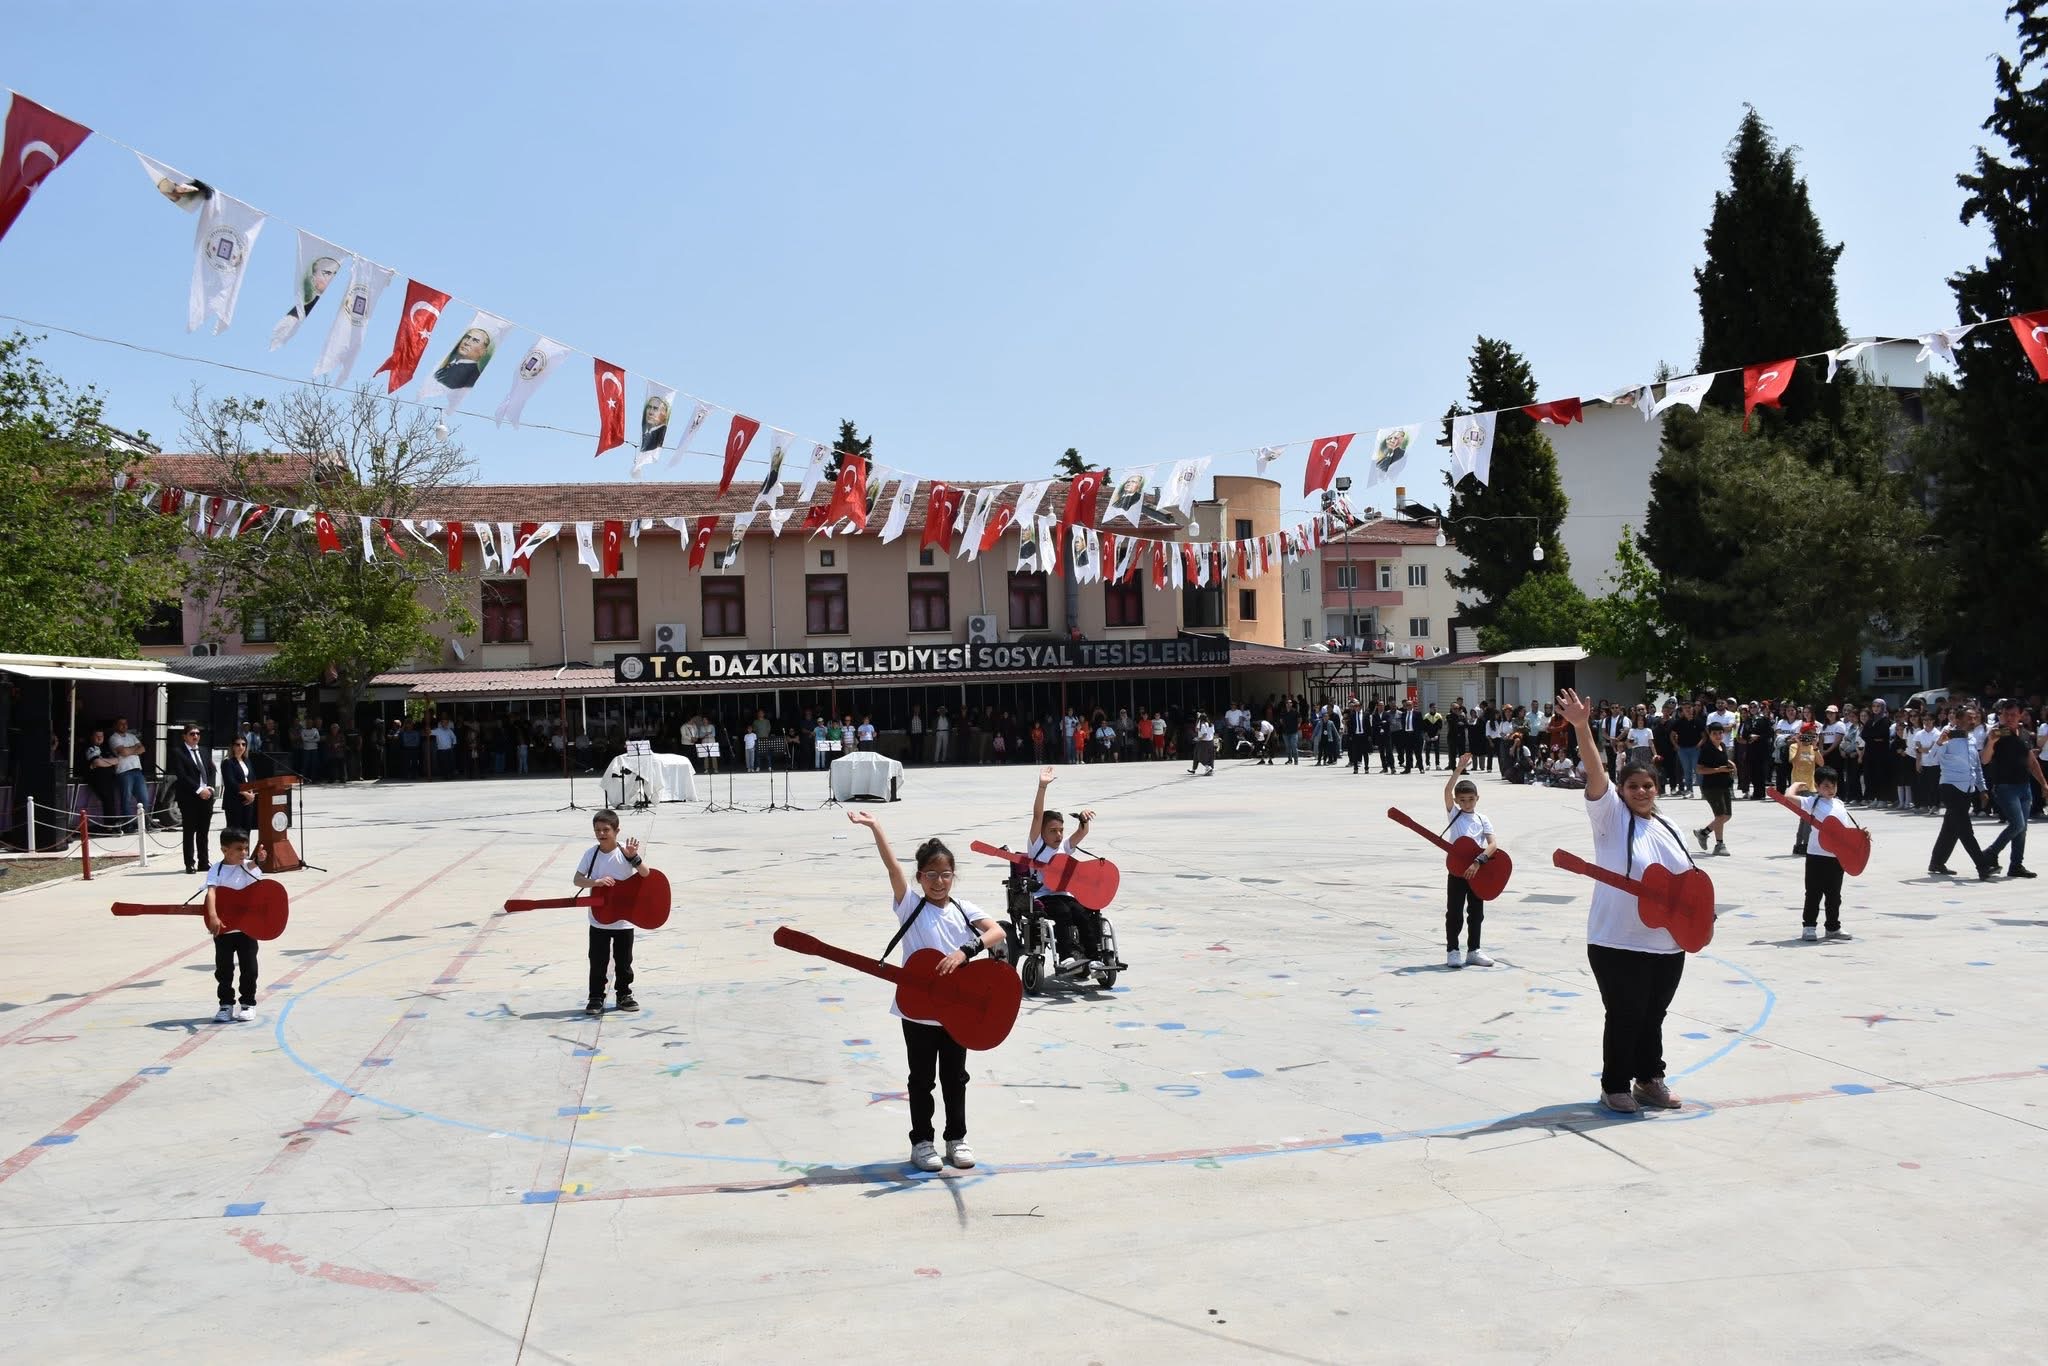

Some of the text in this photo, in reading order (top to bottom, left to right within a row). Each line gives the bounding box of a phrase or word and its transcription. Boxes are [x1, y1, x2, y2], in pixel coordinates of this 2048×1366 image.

[650, 656, 701, 678] T.C.
[709, 652, 815, 677] DAZKIRI
[823, 644, 971, 673] BELEDİYESİ
[978, 645, 1073, 668] SOSYAL
